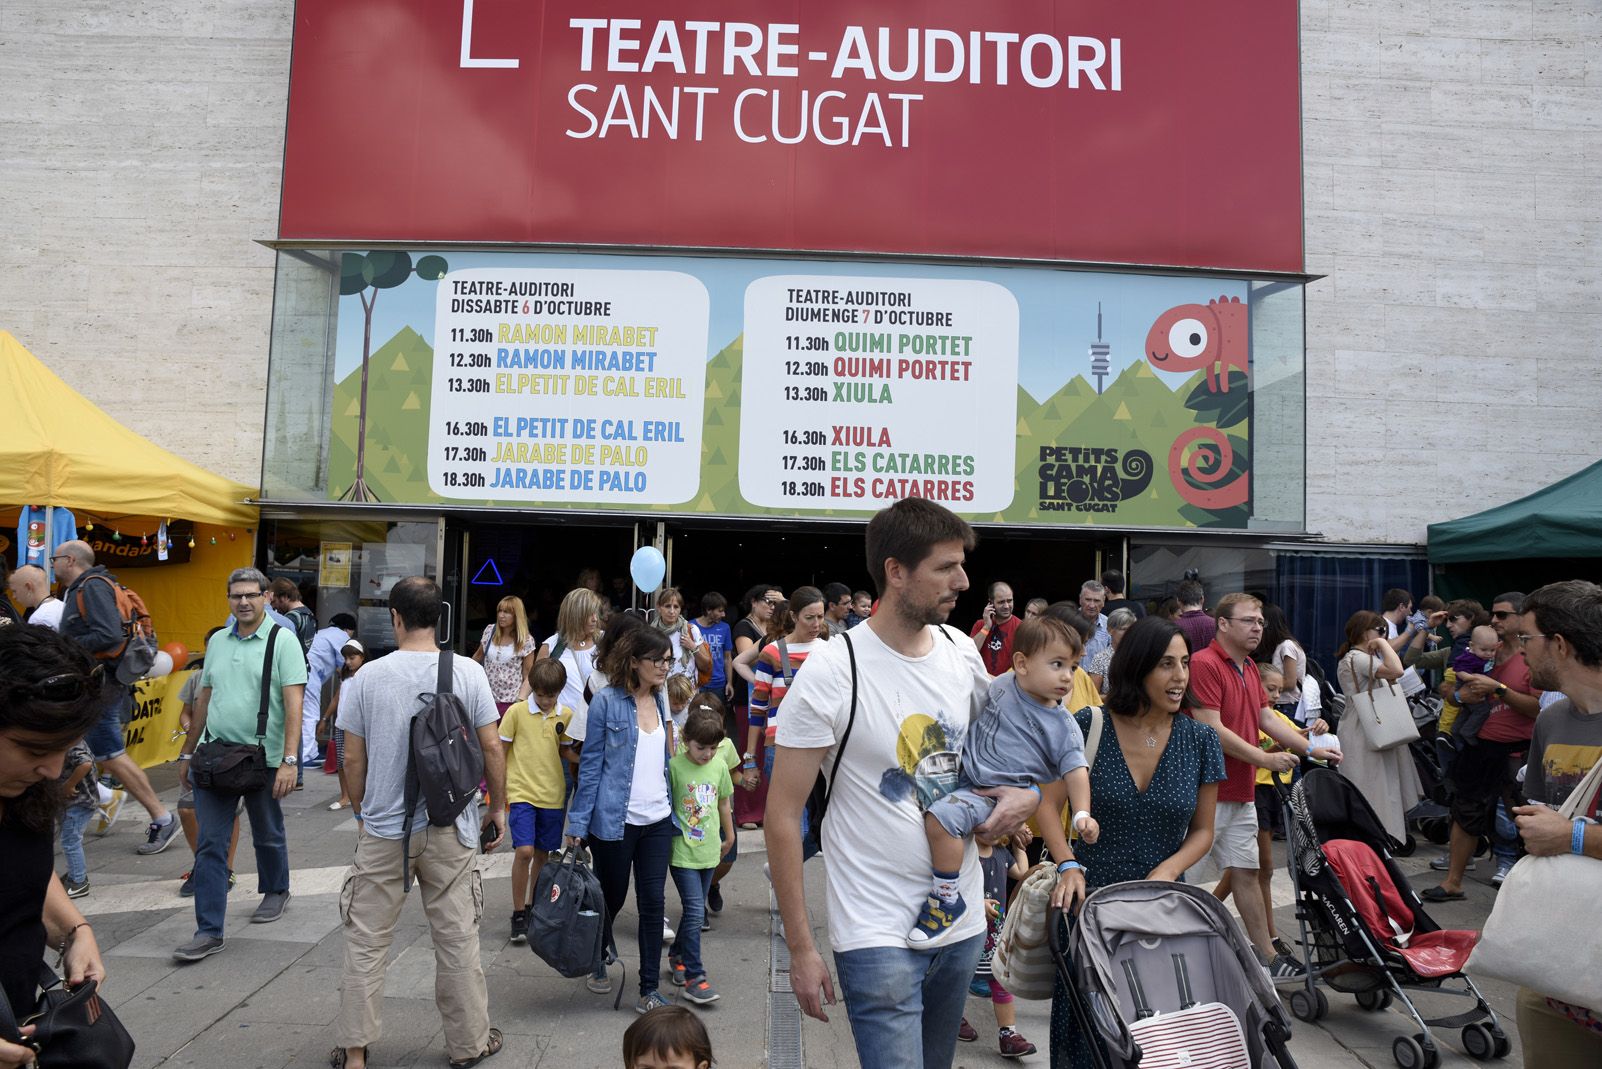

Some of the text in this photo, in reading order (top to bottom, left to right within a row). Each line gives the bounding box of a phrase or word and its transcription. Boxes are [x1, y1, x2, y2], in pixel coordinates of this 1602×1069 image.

[568, 18, 1121, 92] TEATRE-AUDITORI
[566, 84, 923, 147] SANT CUGAT
[453, 281, 574, 297] TEATRE-AUDITORI
[787, 289, 911, 307] TEATRE-AUDITORI
[452, 299, 611, 316] DISSABTE 6 D'OCTUBRE
[786, 307, 952, 327] DIUMENGE 7 D'OCTUBRE
[451, 323, 658, 347] 11.30h RAMON MIRABET
[786, 332, 972, 356] 11.30h QUIMI PORTET
[450, 348, 657, 372] 12.30h RAMON MIRABET
[785, 357, 972, 381] 12.30h QUIMI PORTET
[448, 378, 490, 393] 13.30h
[574, 375, 598, 396] DE
[603, 376, 639, 397] CAL
[644, 377, 686, 398] ERIL
[785, 382, 892, 404] 13.30h XIULA
[446, 421, 488, 436] 16.30h
[573, 419, 596, 439] DE
[601, 420, 637, 440] CAL
[643, 421, 684, 442] ERIL
[783, 426, 891, 448] 16.30h XIULA
[444, 442, 648, 467] 17.30h JARABE DE PALO
[782, 451, 974, 476] 17.30h ELS CATARRES
[443, 468, 646, 492] 18.30h JARABE DE PALO
[782, 477, 974, 501] 18.30h ELS CATARRES
[1039, 502, 1117, 512] SANT CUGAT
[1322, 894, 1350, 936] MACLAREN
